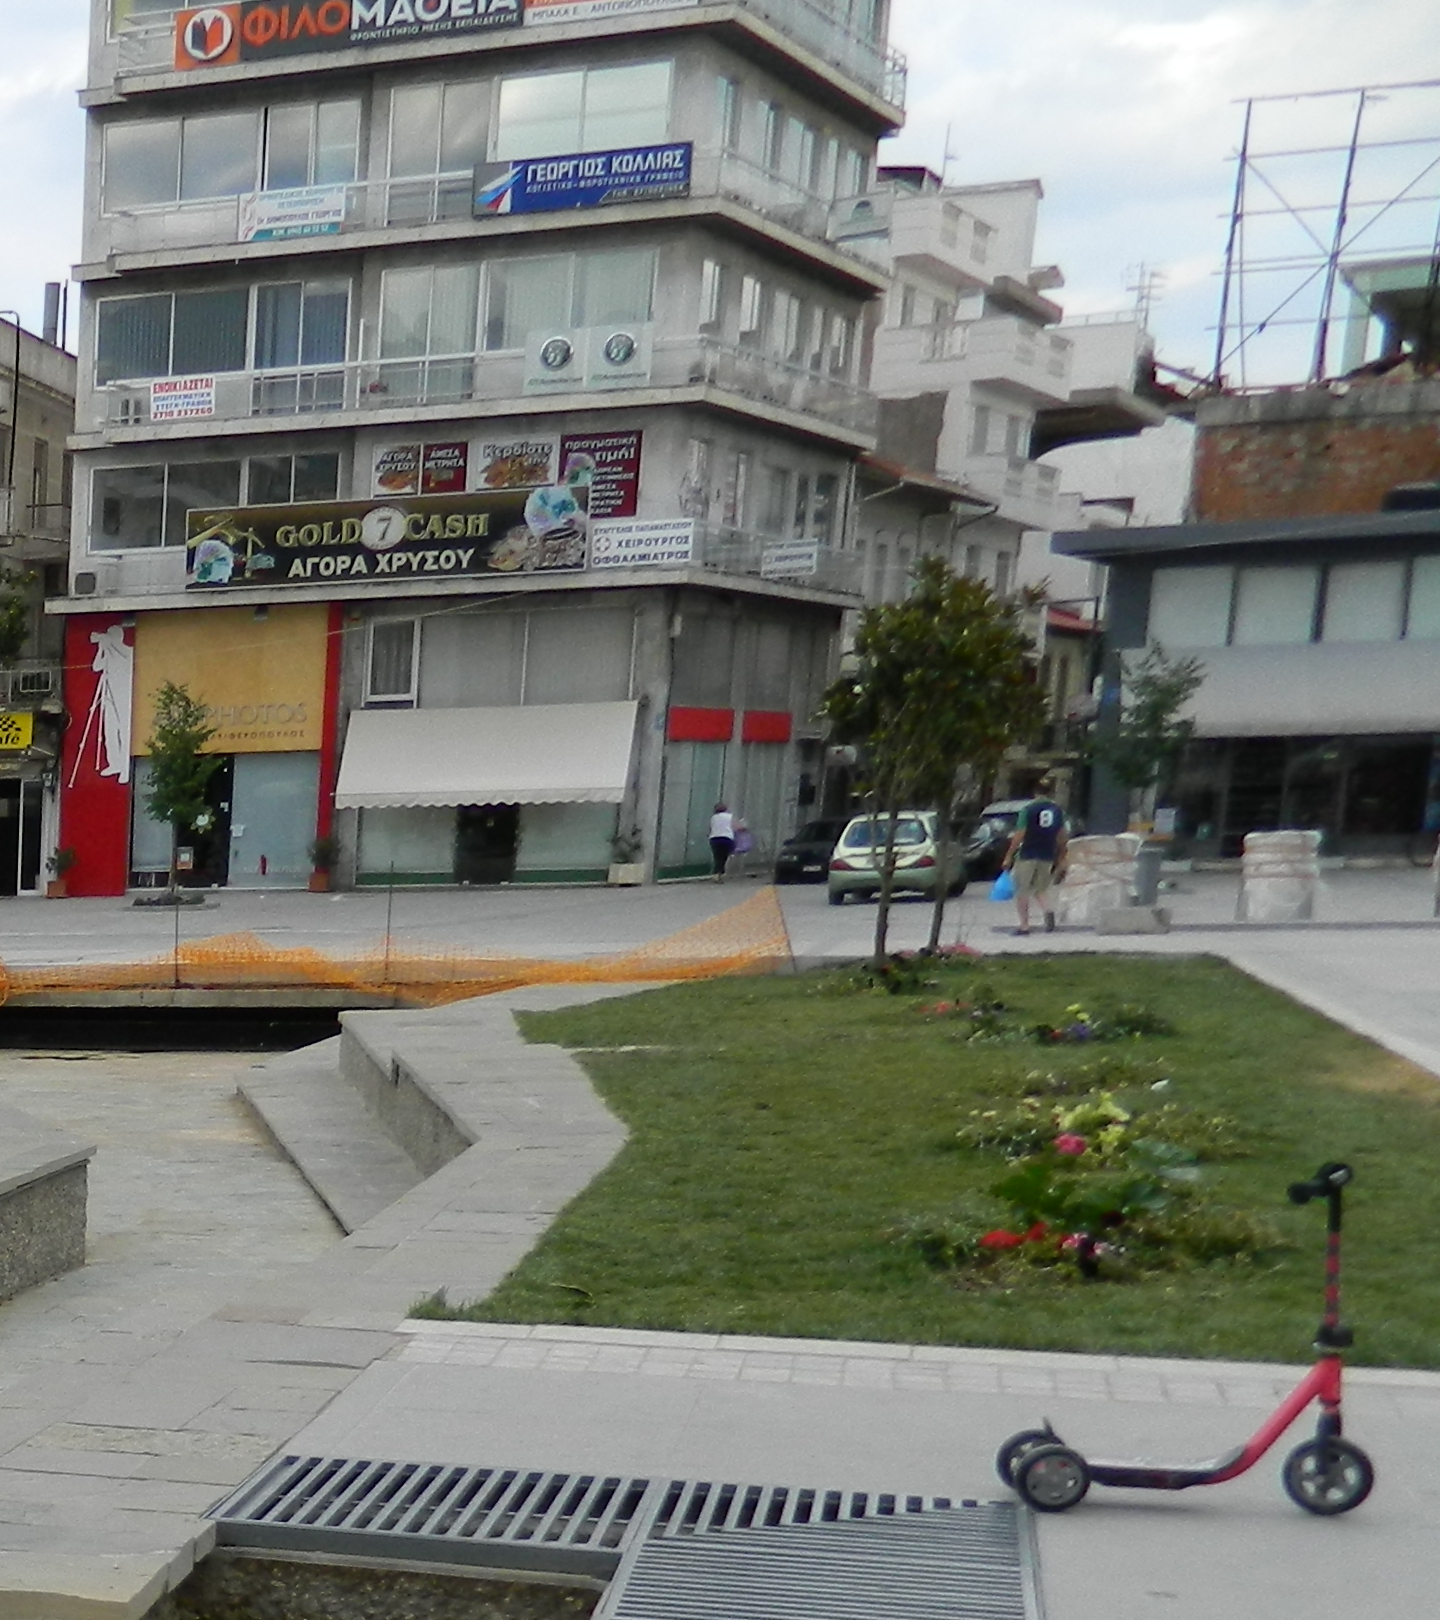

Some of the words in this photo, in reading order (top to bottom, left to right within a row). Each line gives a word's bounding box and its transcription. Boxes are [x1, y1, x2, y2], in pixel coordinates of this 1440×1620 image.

[526, 157, 607, 184] ΓΕΩΡΓΙΟΣ
[611, 149, 685, 174] ΚΟΛΛΙΑΣ
[153, 378, 213, 394] ΕΝΟΙΚΙΑΖΕΤΑΙ
[275, 517, 362, 548] GOLD
[375, 516, 392, 542] 7
[403, 512, 490, 541] CASH
[616, 535, 690, 549] ΧΕΙΡΟΥΡΓΟΣ
[288, 554, 368, 579] ΑΓΟΡΑ
[375, 548, 475, 574] ΧΡΥΣΟΥ
[593, 550, 690, 565] ΟΦΘΑΛΜΙΑΤΡΟΣ
